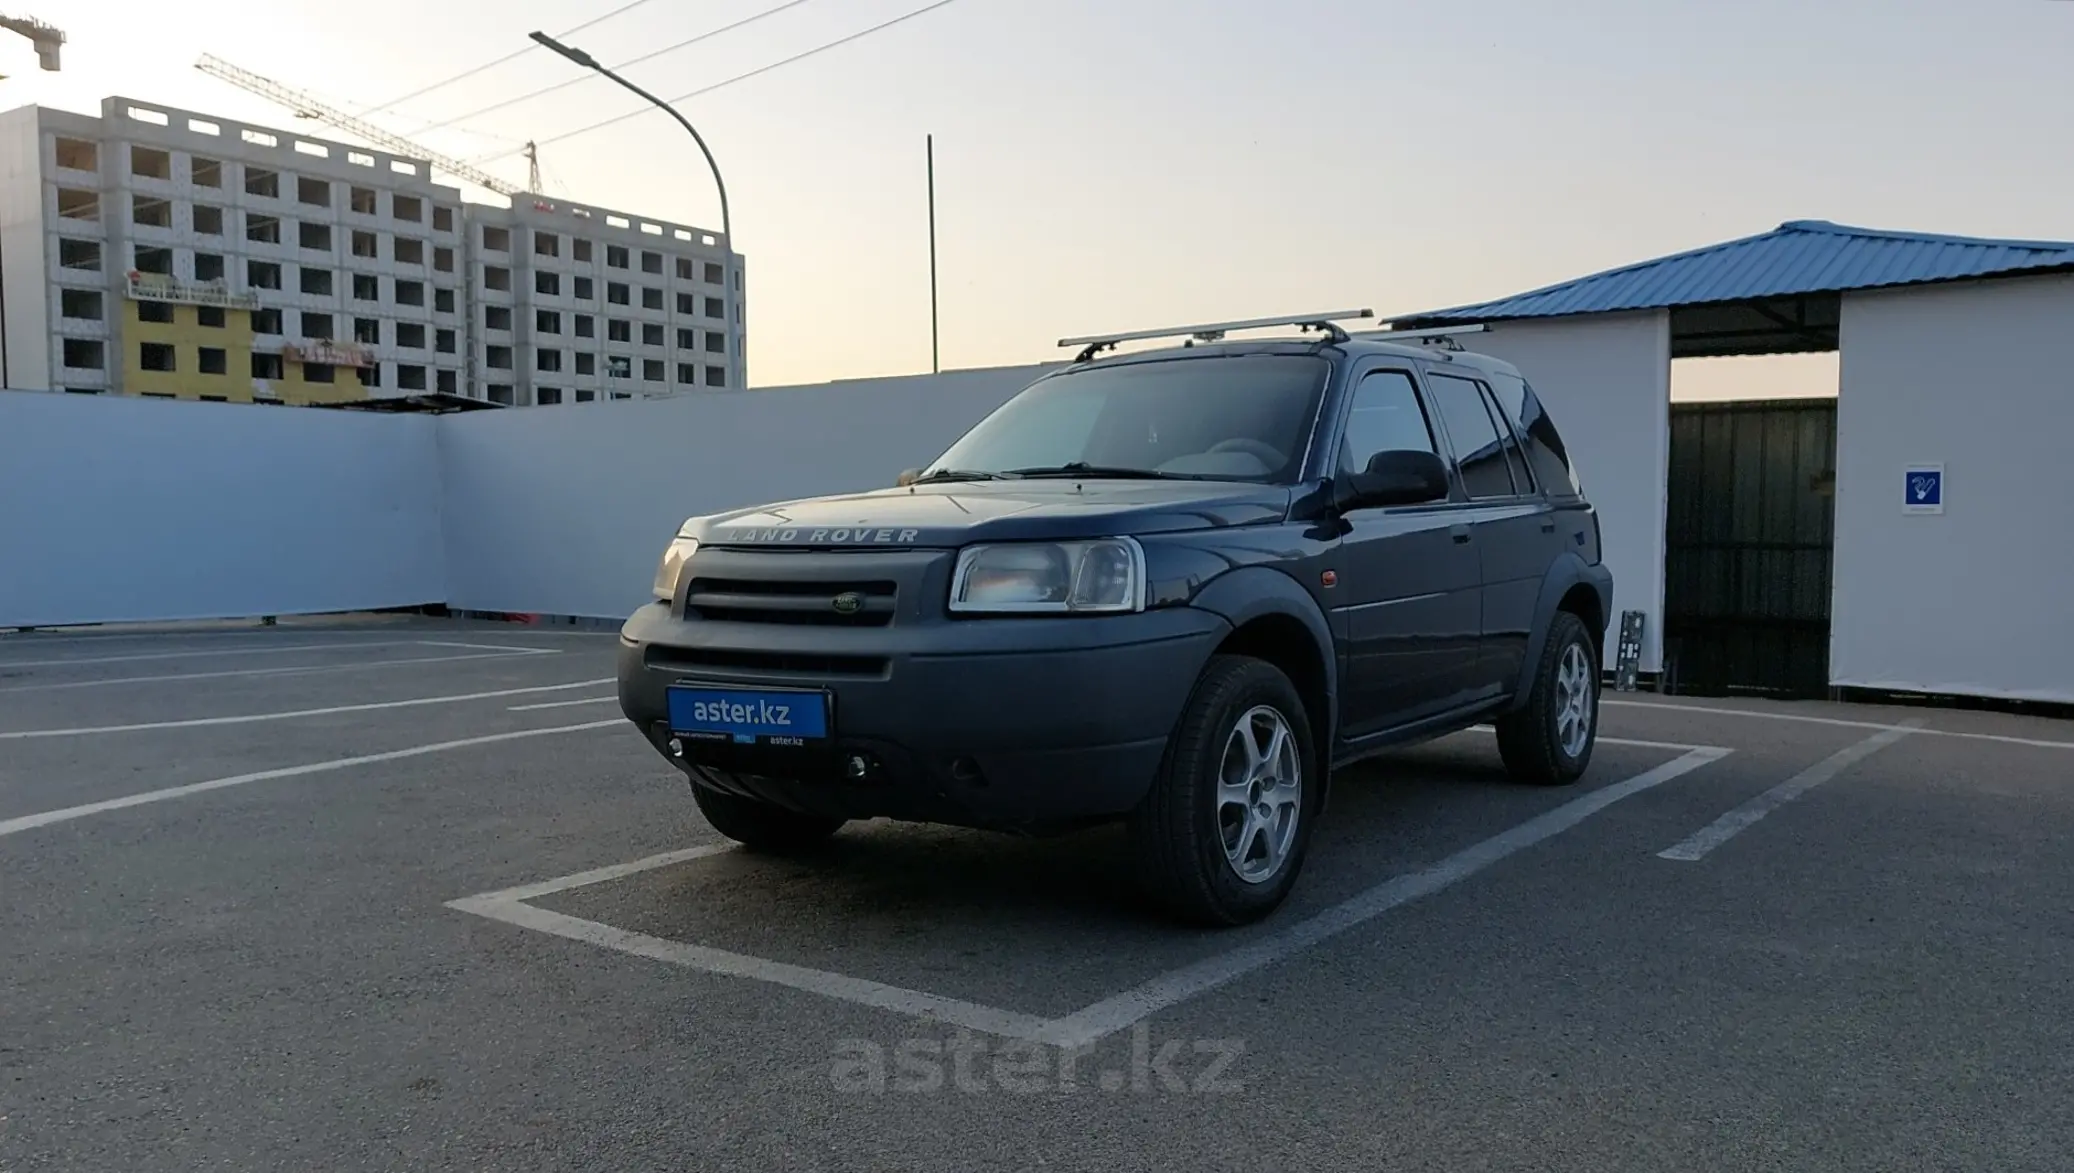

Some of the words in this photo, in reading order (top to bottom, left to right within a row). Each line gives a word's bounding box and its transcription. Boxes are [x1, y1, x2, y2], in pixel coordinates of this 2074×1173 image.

[727, 528, 799, 543] LAND
[810, 528, 919, 543] ROVER
[694, 699, 792, 726] aster.kz
[770, 736, 804, 747] aster.kz
